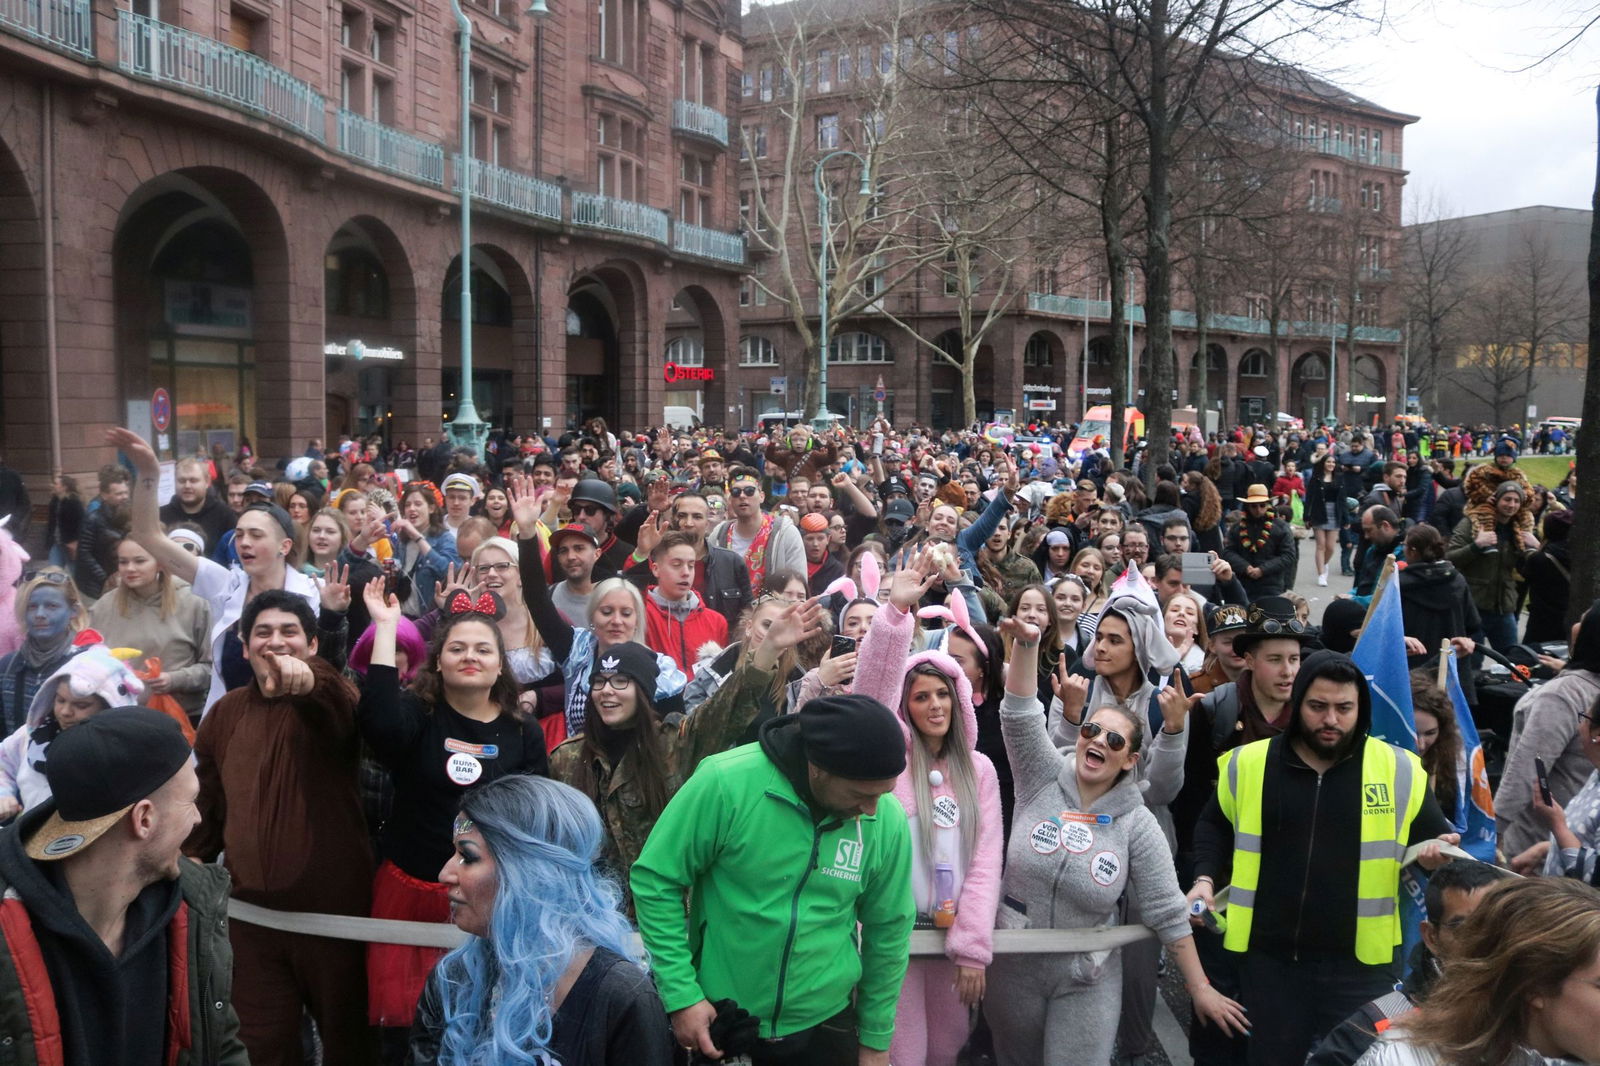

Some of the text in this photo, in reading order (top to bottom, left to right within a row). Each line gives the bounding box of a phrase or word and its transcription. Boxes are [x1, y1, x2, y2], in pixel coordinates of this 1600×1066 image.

[664, 361, 715, 382] OSTERIA
[453, 759, 477, 768] BUMS
[455, 765, 474, 774] BAR
[1363, 807, 1396, 816] ORDNER
[1042, 823, 1058, 834] VOR
[1098, 856, 1118, 872] BUMS
[1098, 864, 1113, 877] BAR
